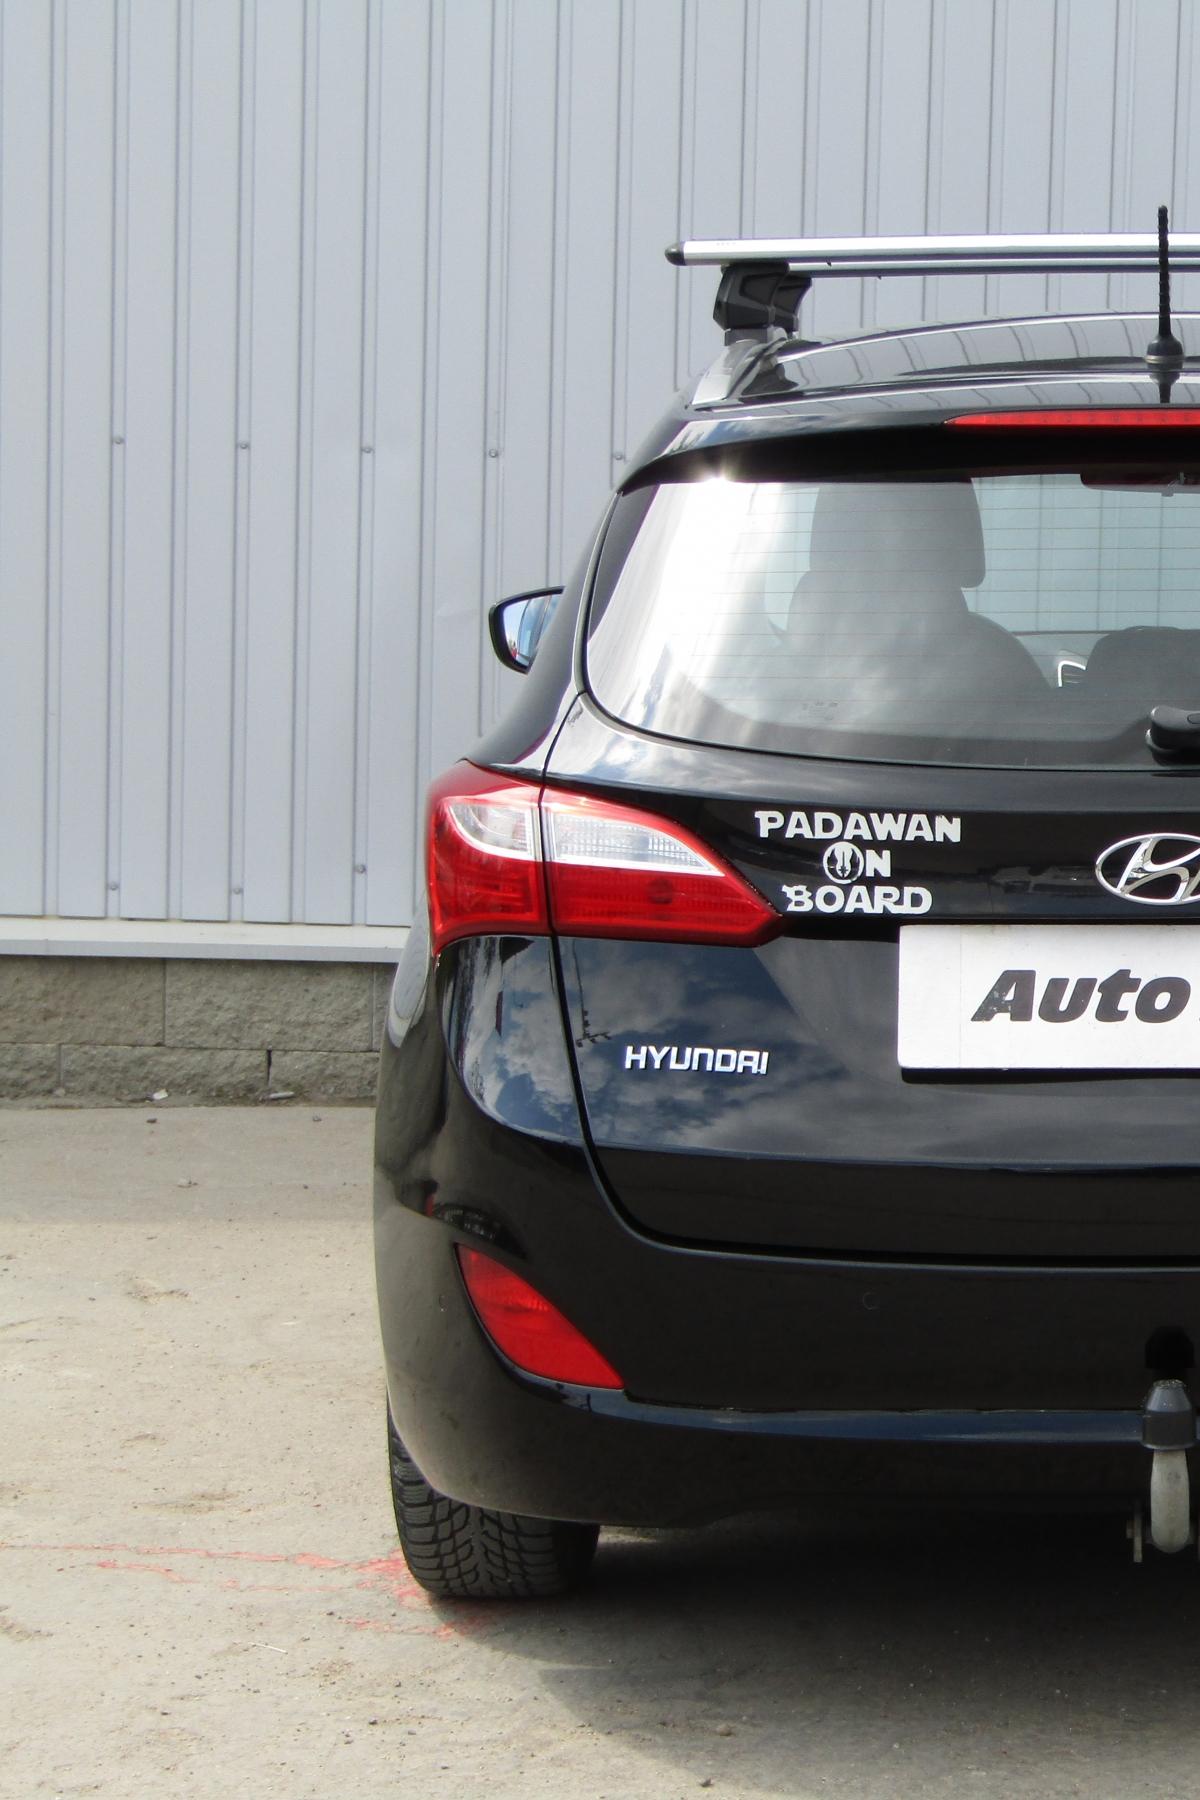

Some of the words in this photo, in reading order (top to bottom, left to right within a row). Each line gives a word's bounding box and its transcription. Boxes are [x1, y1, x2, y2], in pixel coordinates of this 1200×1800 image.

[755, 810, 961, 843] PADAWAN
[782, 884, 933, 915] BOARD
[971, 969, 1191, 1023] Auto
[624, 1045, 769, 1075] HYUNDAI
